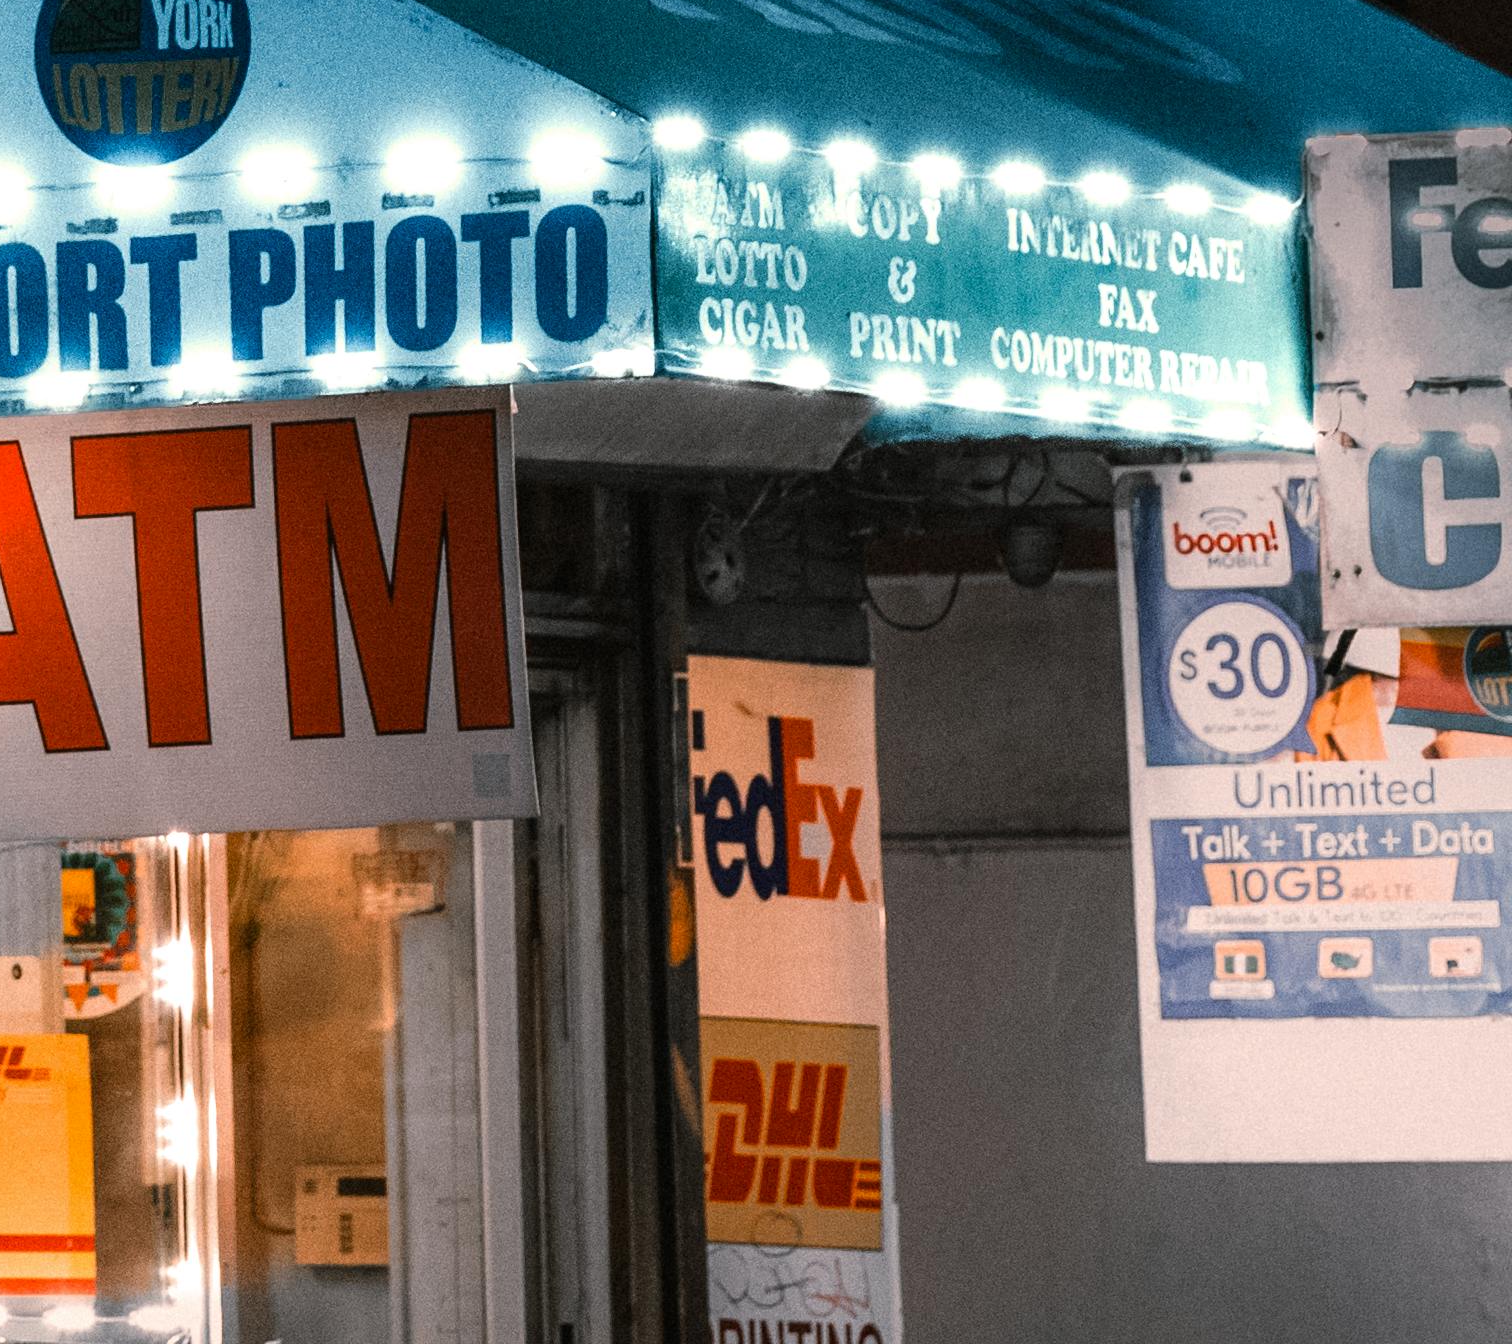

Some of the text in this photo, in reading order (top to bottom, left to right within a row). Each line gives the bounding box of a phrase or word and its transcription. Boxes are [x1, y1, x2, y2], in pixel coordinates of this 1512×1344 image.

[52, 56, 240, 135] LOTTERY
[846, 190, 942, 246] COPY
[1006, 207, 1246, 285] INTERNET CAFE
[228, 202, 610, 363] PHOTO
[694, 235, 808, 292] LOTTO
[888, 256, 917, 304] &
[698, 296, 811, 353] CIGAR
[1097, 282, 1161, 335] FAX
[850, 311, 962, 367] PRINT
[990, 325, 1272, 407] COMPUTER REPAIR
[1173, 520, 1279, 555] boom!
[693, 710, 867, 902] edEx
[1233, 769, 1436, 809] Unlimited
[1181, 825, 1251, 861] Talk
[1294, 823, 1370, 858] Text
[1411, 820, 1496, 856] Data
[1230, 865, 1345, 903] 10GB
[707, 1057, 857, 1208] DHL
